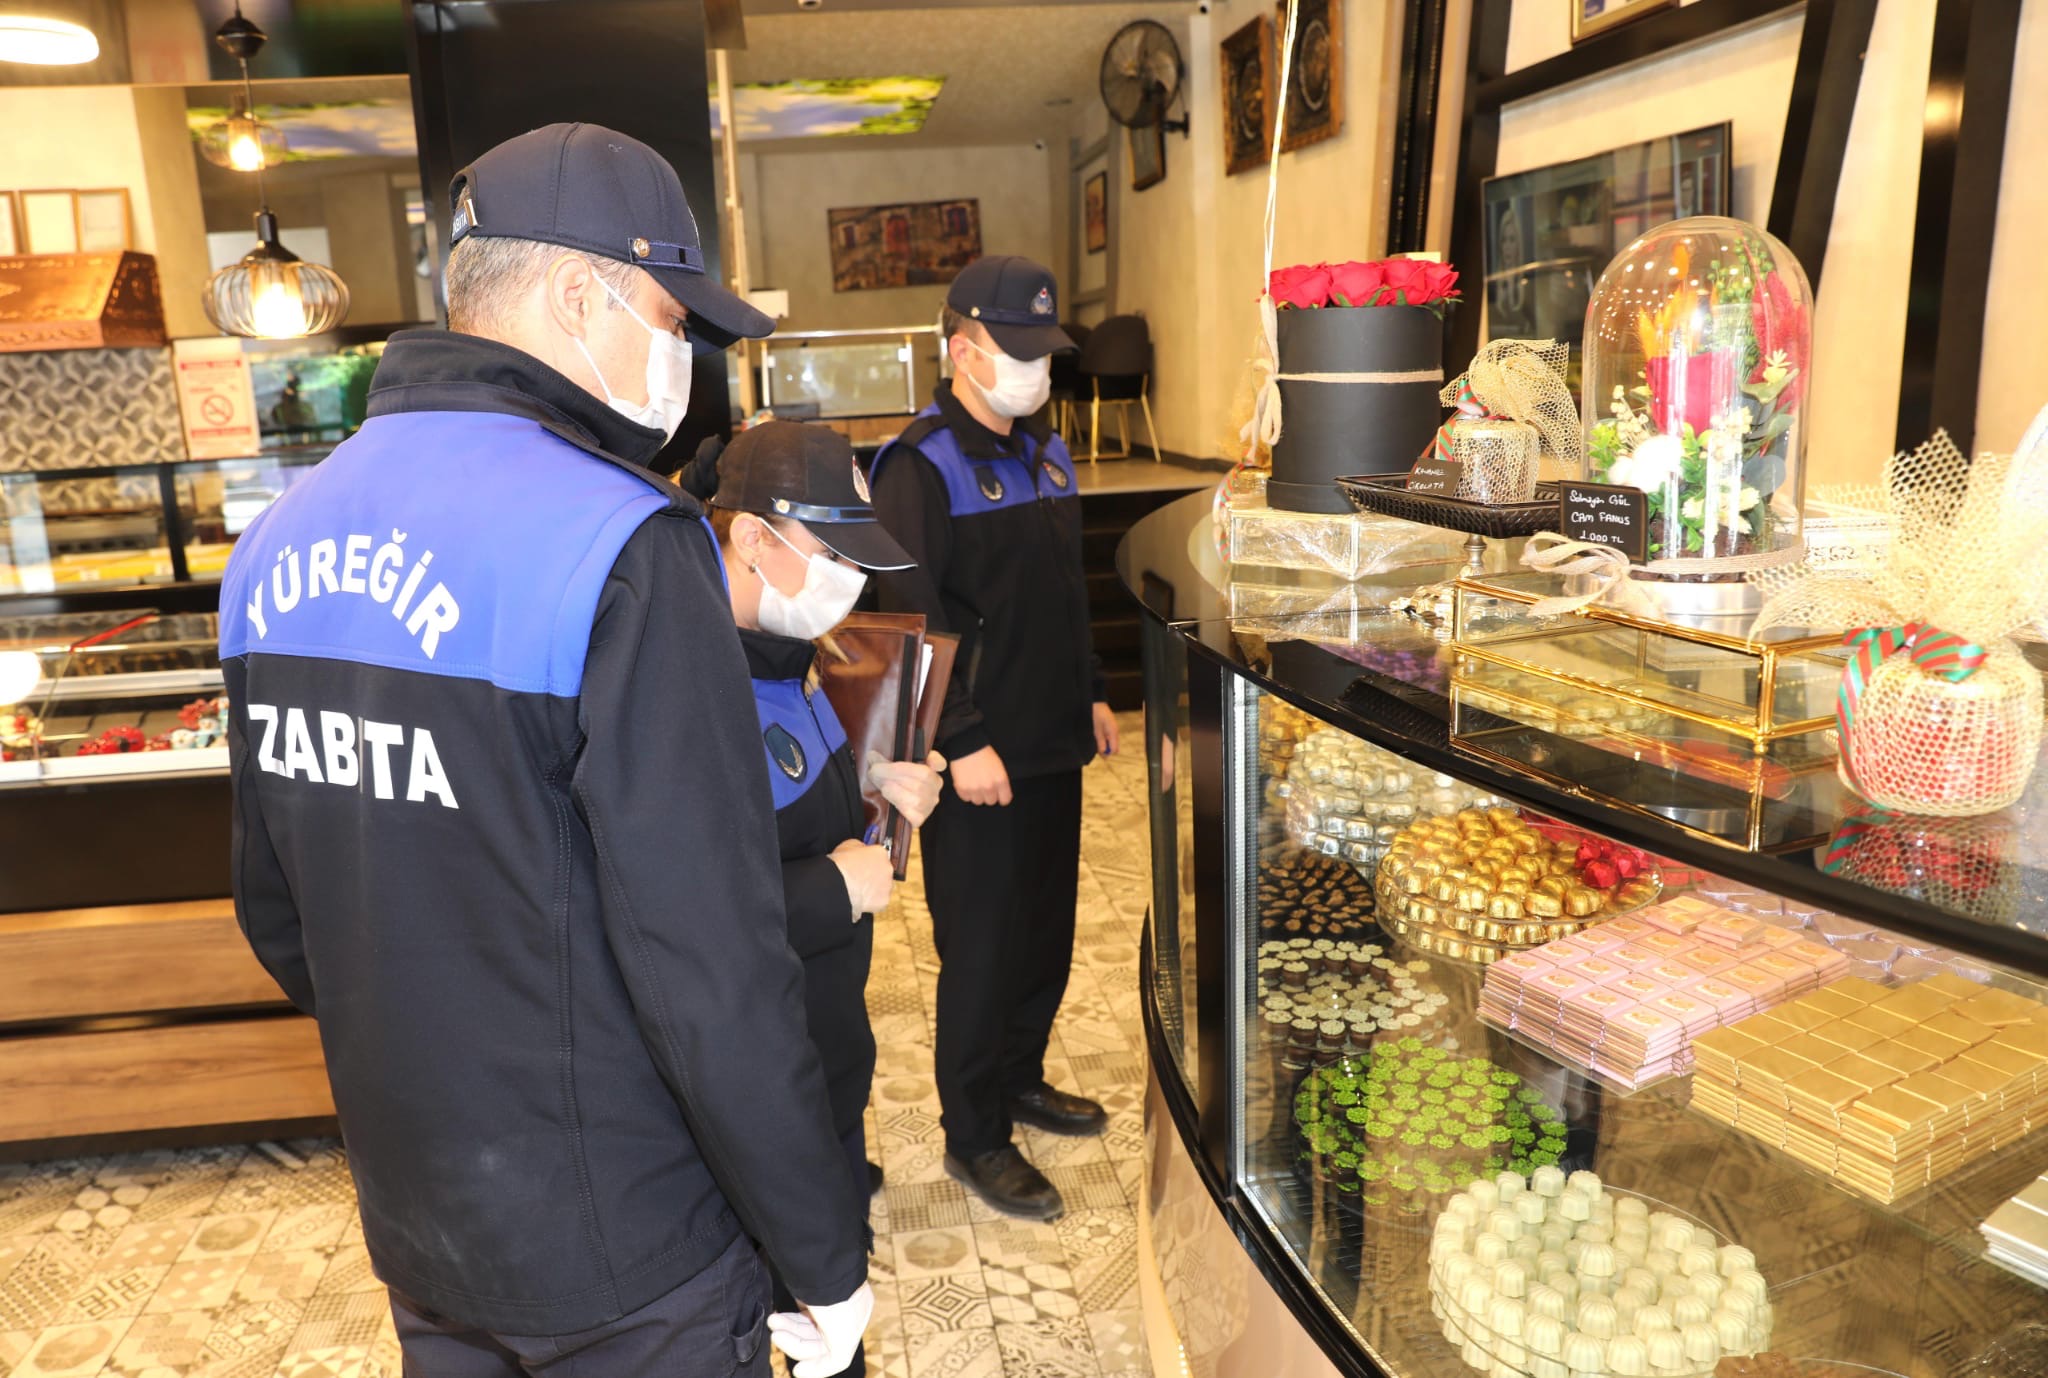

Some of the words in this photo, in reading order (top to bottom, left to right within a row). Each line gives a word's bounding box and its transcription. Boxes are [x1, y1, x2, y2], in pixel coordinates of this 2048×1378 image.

[1599, 511, 1631, 526] FANUS
[1611, 535, 1625, 544] TL
[247, 527, 460, 660] YÜREĞİR
[247, 703, 460, 809] ZABTA
